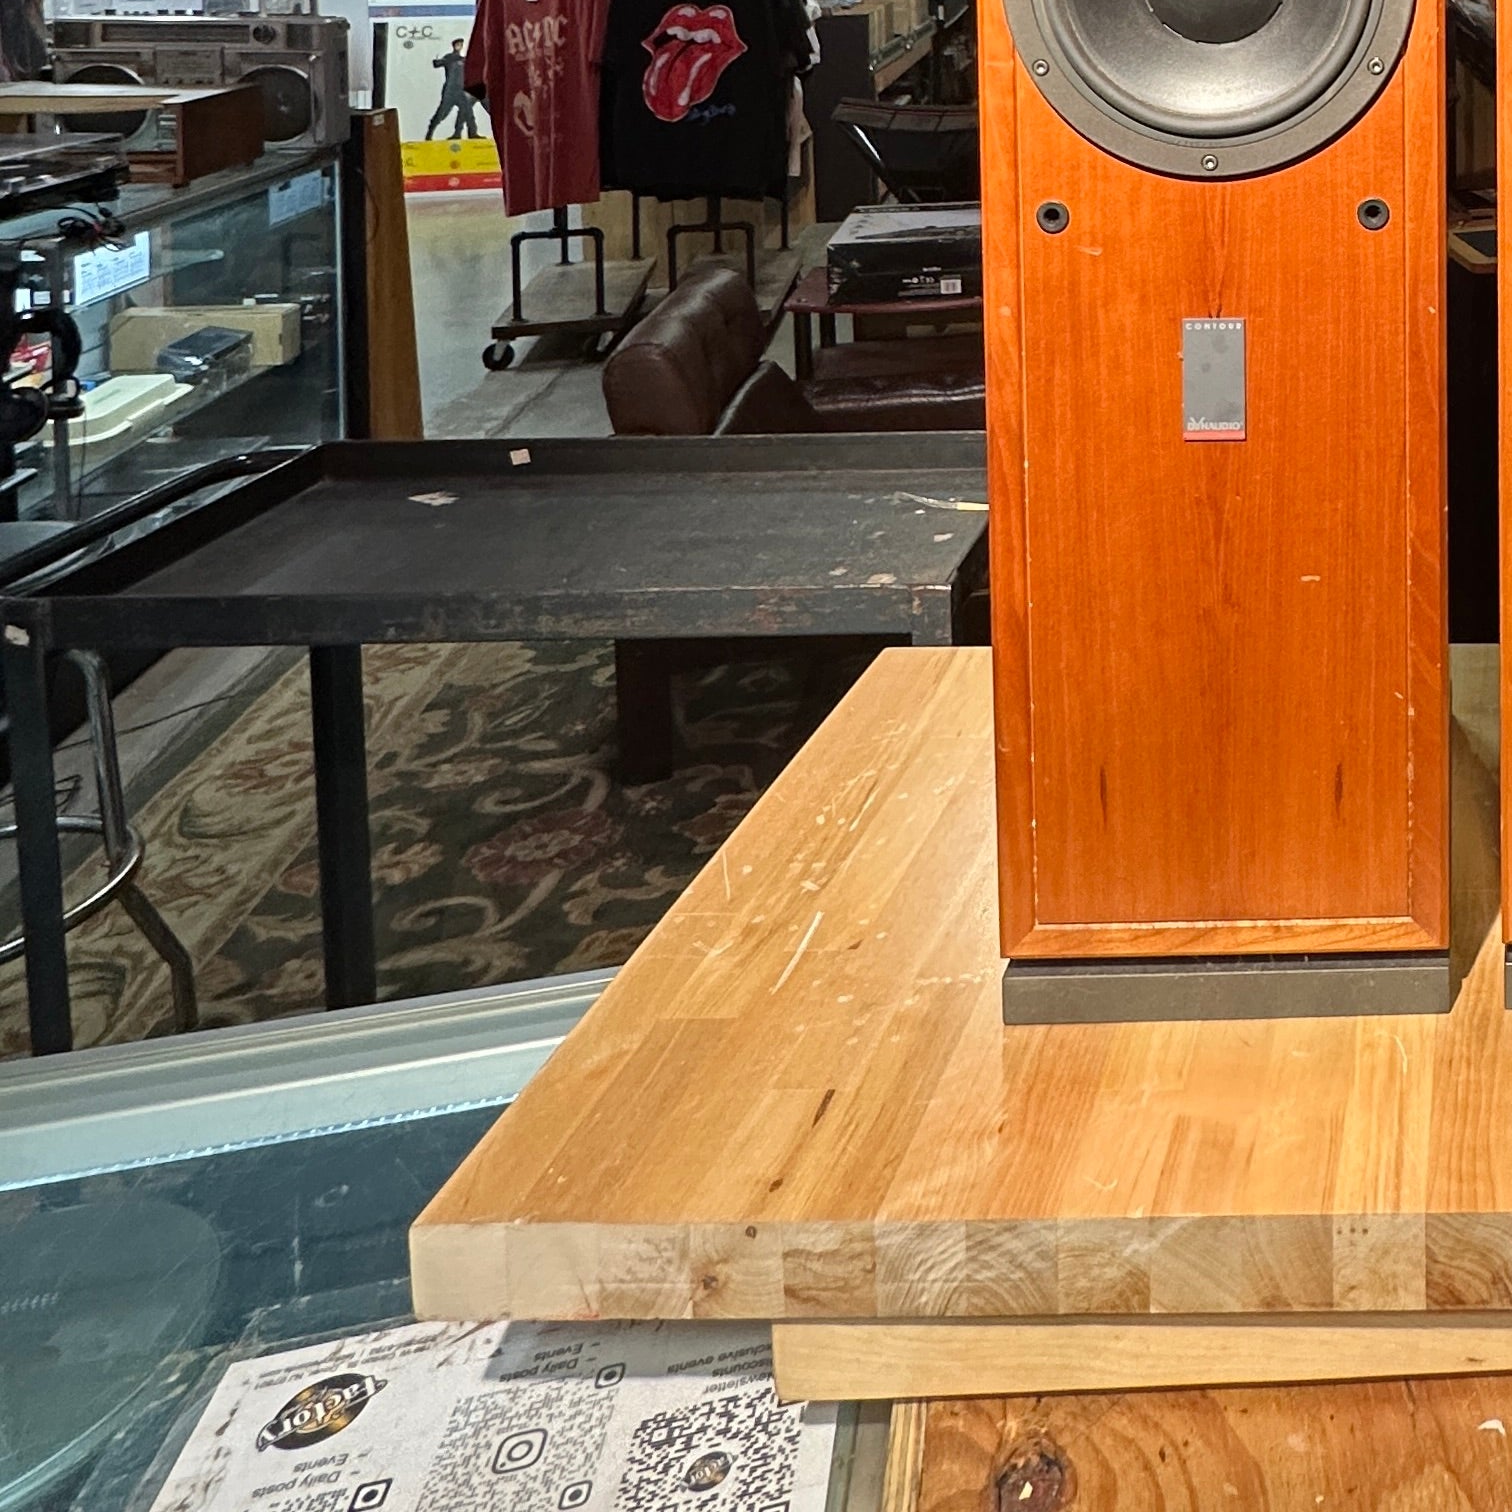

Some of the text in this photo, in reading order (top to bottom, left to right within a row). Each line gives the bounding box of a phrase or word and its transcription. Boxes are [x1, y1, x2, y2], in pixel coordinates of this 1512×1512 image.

[1184, 322, 1242, 331] CONTOUR
[1186, 416, 1242, 431] DYNAUDIO
[534, 1342, 584, 1362] Events
[499, 1358, 579, 1382] Daily posts
[667, 1355, 714, 1375] events
[712, 1358, 773, 1377] scounts
[256, 1375, 388, 1452] Factory
[293, 1453, 349, 1473] Events
[251, 1470, 341, 1498] Daily posts
